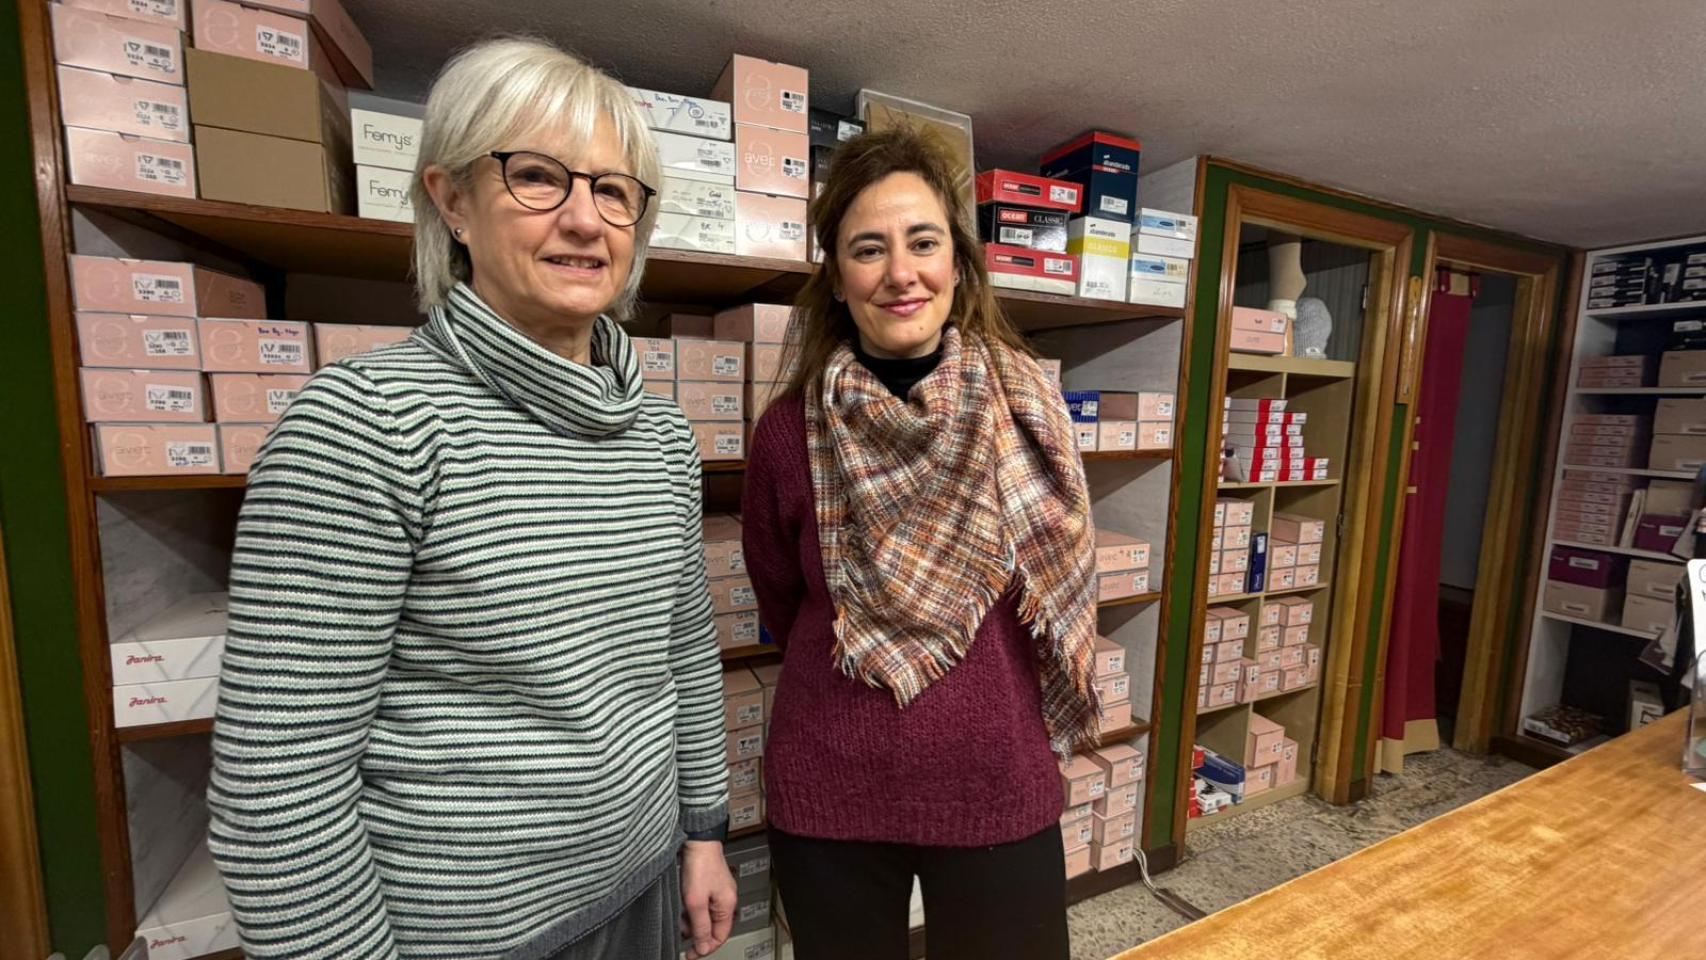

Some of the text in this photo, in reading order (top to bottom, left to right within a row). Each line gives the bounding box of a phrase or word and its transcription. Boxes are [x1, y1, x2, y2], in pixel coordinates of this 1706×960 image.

[363, 123, 412, 151] Ferrys
[745, 152, 776, 167] avec
[369, 179, 409, 206] Ferry
[126, 655, 165, 665] Janira
[129, 696, 168, 708] Janira
[150, 935, 187, 950] Janira
